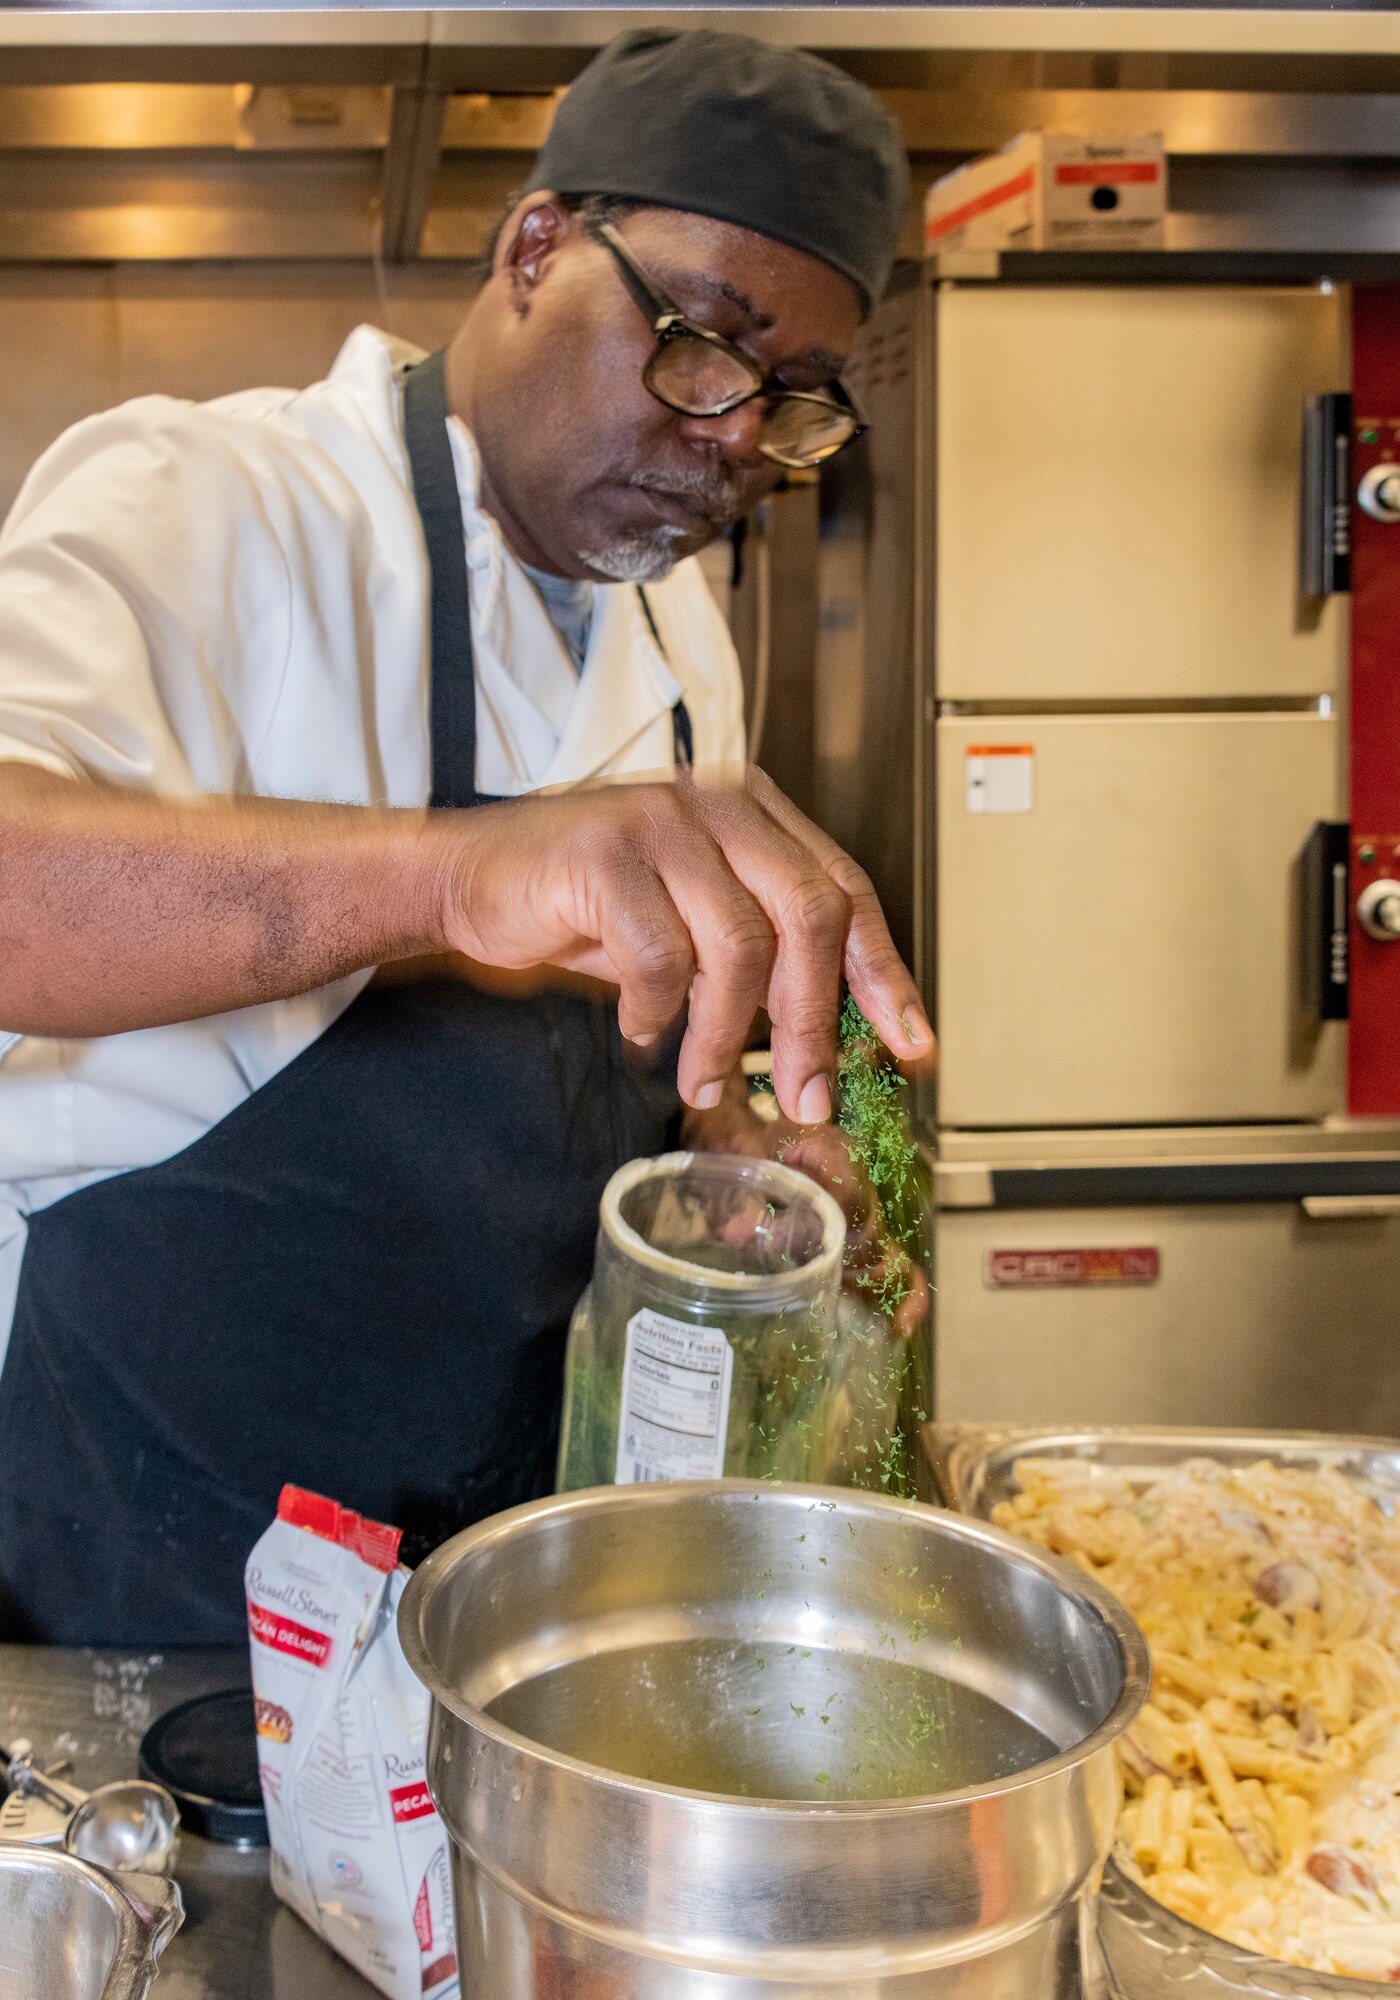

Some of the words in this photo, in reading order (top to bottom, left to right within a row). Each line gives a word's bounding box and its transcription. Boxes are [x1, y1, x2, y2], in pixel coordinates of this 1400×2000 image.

[636, 1322, 685, 1347] Nutrition
[688, 1341, 722, 1354] Facts
[633, 1359, 670, 1381] Calories
[711, 1380, 719, 1390] 0
[277, 1629, 328, 1659] DELIGHT
[393, 1793, 431, 1813] PECA
